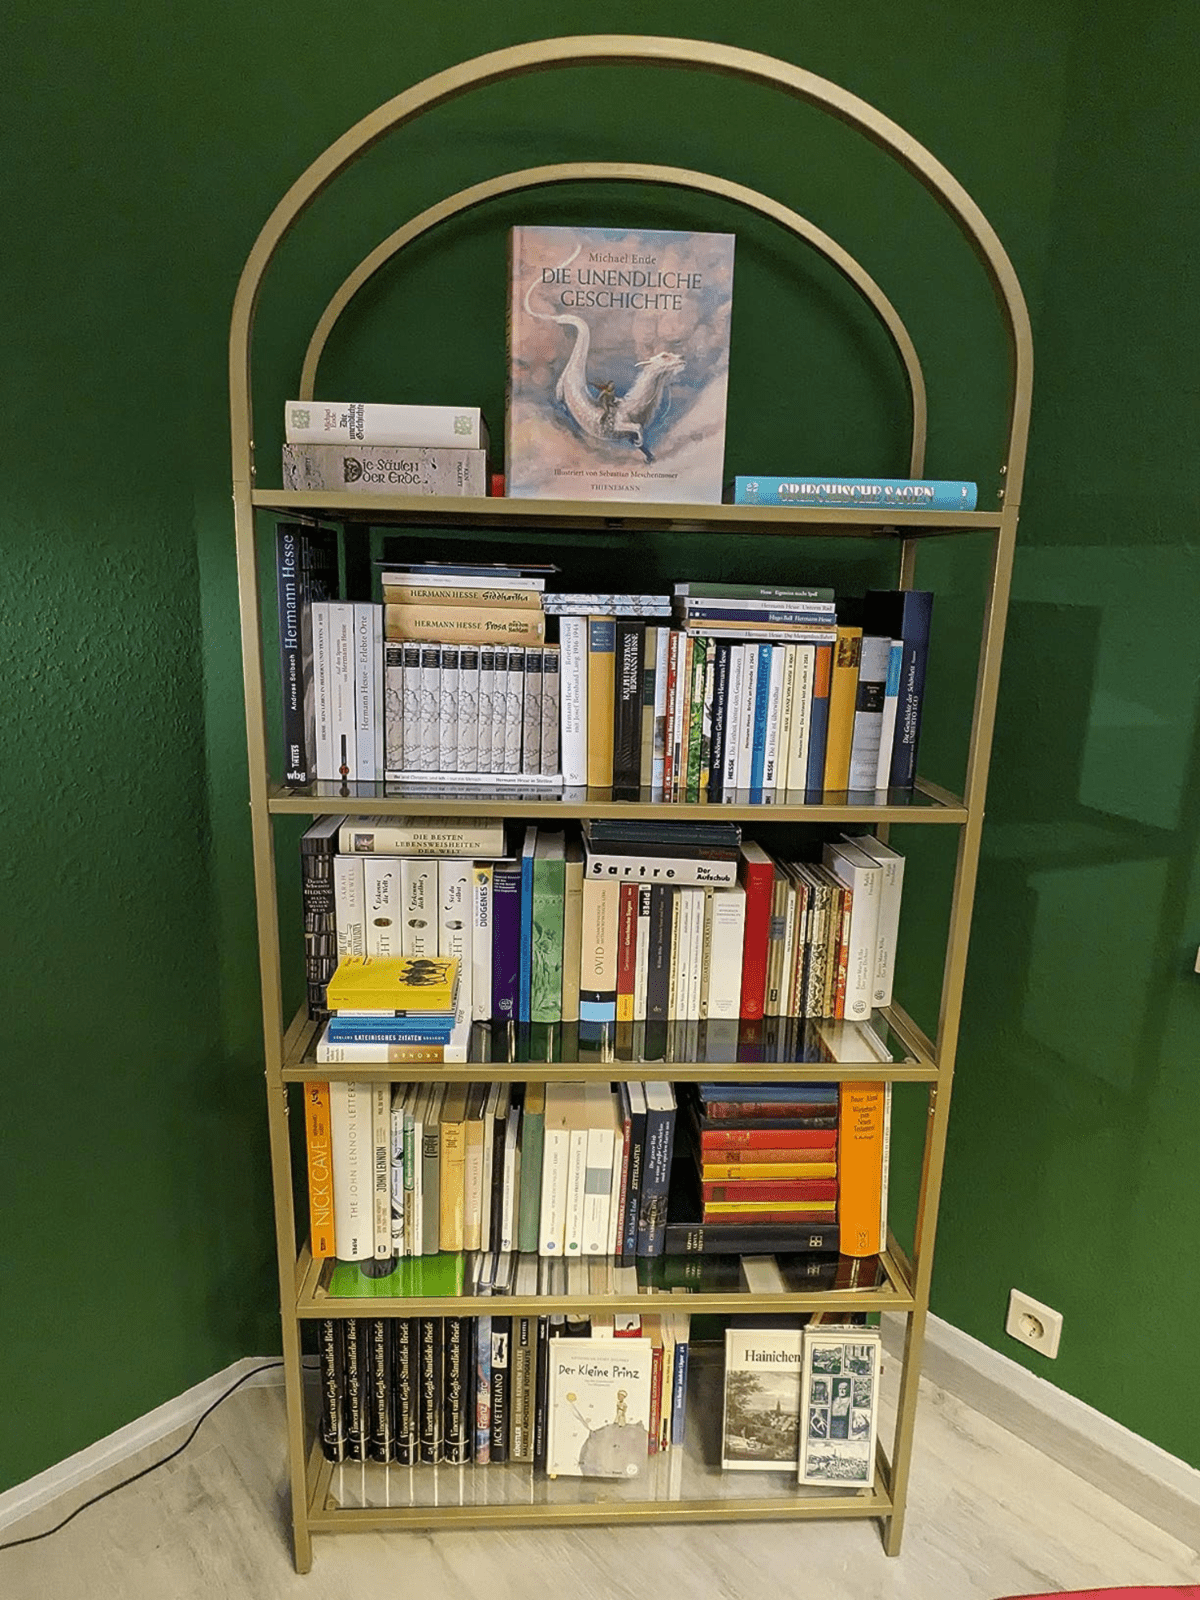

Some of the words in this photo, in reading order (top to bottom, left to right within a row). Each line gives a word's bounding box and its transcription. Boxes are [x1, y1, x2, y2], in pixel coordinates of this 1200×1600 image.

[589, 252, 629, 264] Michael
[632, 254, 657, 264] Ende
[542, 267, 572, 284] DIE
[578, 268, 703, 289] UNENDLICHE
[560, 290, 683, 311] GESCHICHTE
[281, 534, 295, 578] Hesse
[410, 590, 450, 598] HERMANN
[452, 591, 478, 599] HESSE
[283, 582, 298, 649] Hermann
[359, 616, 367, 634] Orte
[414, 620, 454, 628] HERMANN
[359, 636, 368, 663] Erlebte
[360, 671, 368, 693] Hesse
[565, 681, 573, 701] Hesse
[289, 683, 297, 711] Andreas
[360, 696, 369, 731] Hermann
[565, 702, 573, 733] Hermann
[727, 759, 735, 780] HESSE
[766, 760, 774, 781] HESSE
[395, 840, 481, 848] LEBENSWEISHEITEN
[593, 862, 675, 878] Sartre
[697, 874, 731, 882] Aufschub
[449, 886, 455, 894] du
[479, 887, 488, 927] DIOGENES
[642, 892, 650, 915] PIPER
[594, 946, 605, 975] OVID
[347, 1081, 356, 1119] LETTERS
[349, 1123, 357, 1166] LENNON
[310, 1140, 329, 1182] CAVE
[376, 1146, 387, 1172] LENNON
[632, 1143, 641, 1190] ZETTELKASTEN
[349, 1170, 358, 1197] JOHN
[376, 1173, 387, 1193] JOHN
[311, 1185, 331, 1227] NICK
[350, 1202, 358, 1219] THE
[628, 1214, 636, 1236] Michael
[324, 1320, 334, 1342] Briefe
[348, 1319, 356, 1340] Briefe
[374, 1321, 384, 1342] Briefe
[399, 1322, 408, 1344] Briefe
[423, 1321, 433, 1343] Briefe
[450, 1321, 460, 1343] Briefe
[325, 1343, 335, 1377] Sämtliche
[348, 1340, 357, 1375] Sämtliche
[375, 1343, 384, 1378] Sämtliche
[399, 1345, 408, 1379] Sämtliche
[424, 1344, 433, 1378] Sämtliche
[450, 1344, 459, 1378] Sämtliche
[744, 1349, 801, 1364] Hainichen
[559, 1364, 576, 1375] Der
[578, 1364, 609, 1378] Kleine
[613, 1366, 640, 1379] Prinz
[327, 1379, 338, 1398] Gogh
[348, 1377, 360, 1396] Gogh
[376, 1380, 387, 1399] Gogh
[400, 1382, 411, 1401] Gogh
[424, 1381, 436, 1399] Gogh
[449, 1381, 462, 1399] Gogh
[480, 1382, 488, 1400] arc
[328, 1398, 336, 1411] van
[425, 1400, 433, 1411] van
[494, 1373, 503, 1424] VETTRIANO
[328, 1411, 338, 1436] Vincent
[348, 1409, 359, 1433] Vincent
[376, 1411, 385, 1436] Vincent
[400, 1413, 409, 1438] Vincent
[424, 1412, 433, 1436] Vincent
[449, 1412, 458, 1437] Vincent
[478, 1406, 488, 1429] Franz
[493, 1426, 503, 1446] JACK
[513, 1426, 521, 1457] KÜNSTLER
